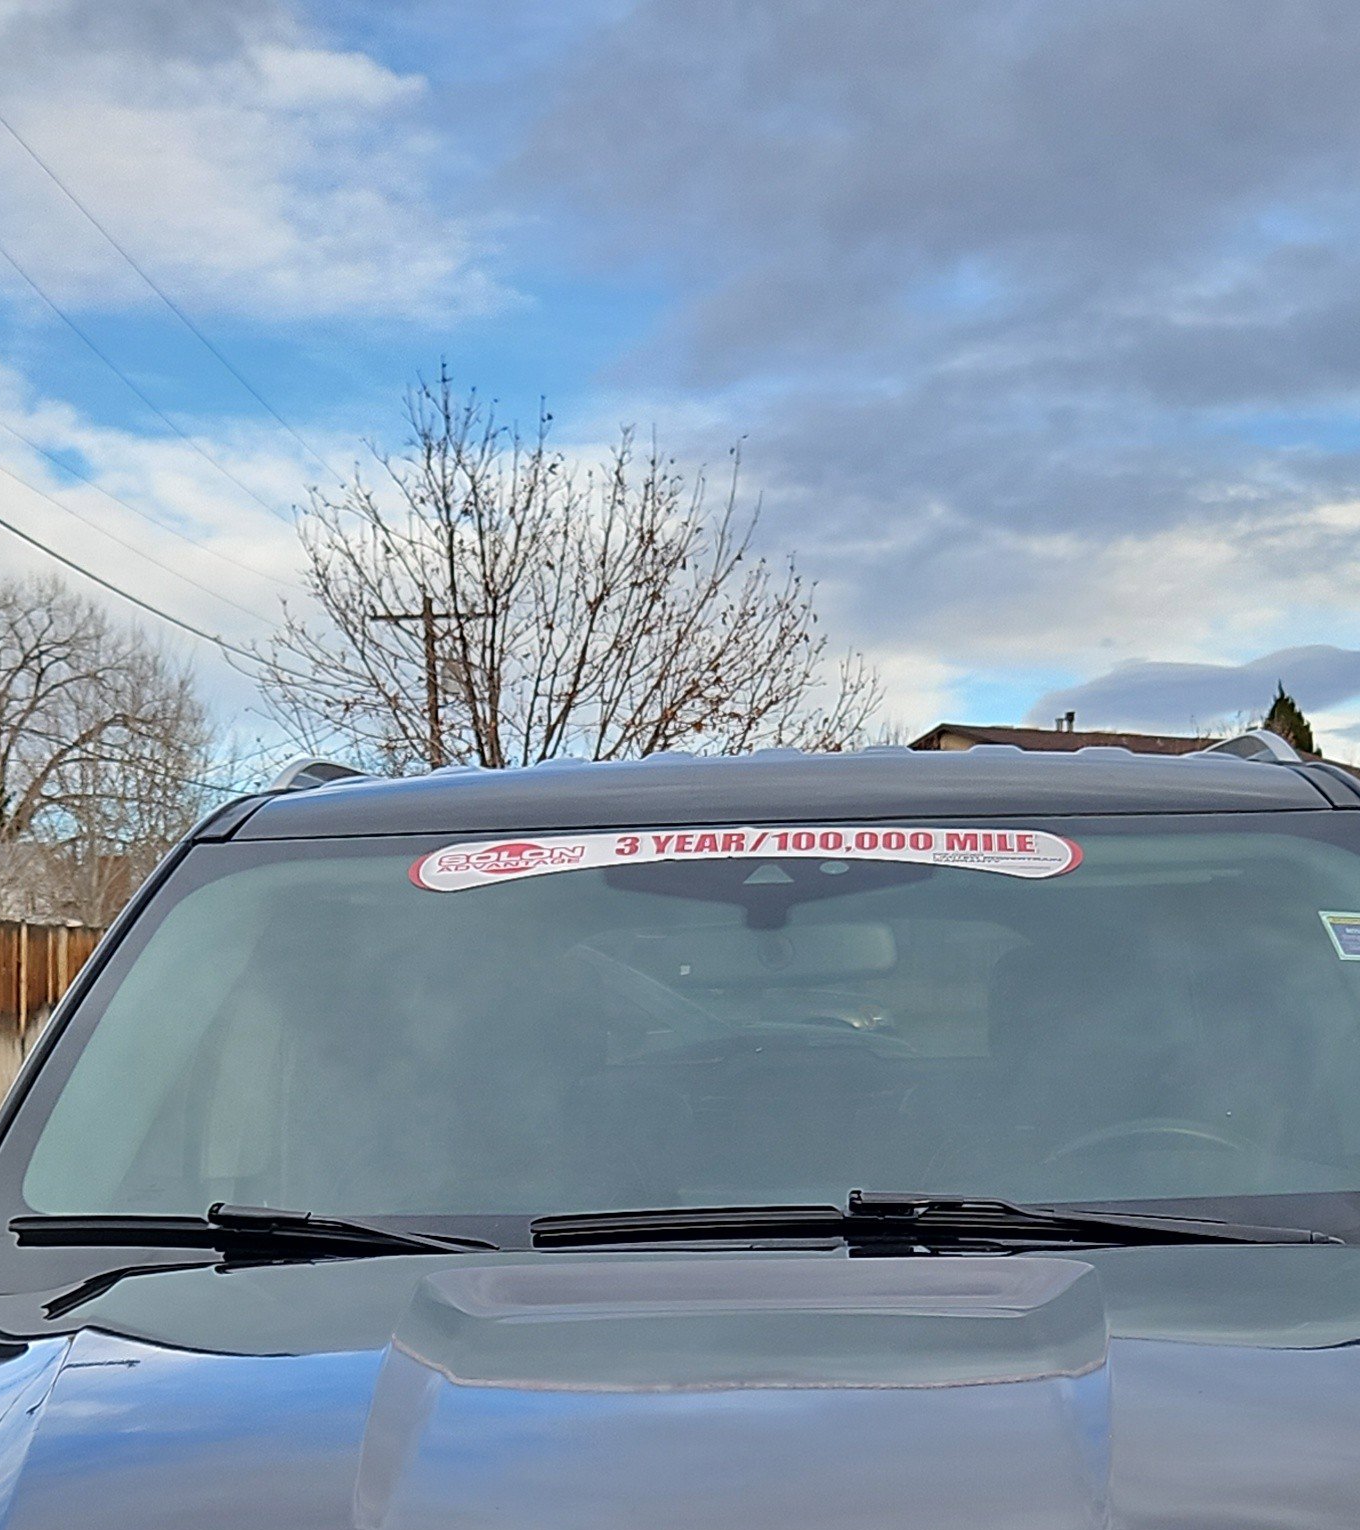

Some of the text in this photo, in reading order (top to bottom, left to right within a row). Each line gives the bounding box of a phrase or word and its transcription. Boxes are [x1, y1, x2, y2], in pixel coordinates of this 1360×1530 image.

[615, 831, 1035, 856] 3 YEAR/100,000 MILE
[436, 856, 581, 873] ADVANTAGE
[438, 846, 585, 866] SOLON
